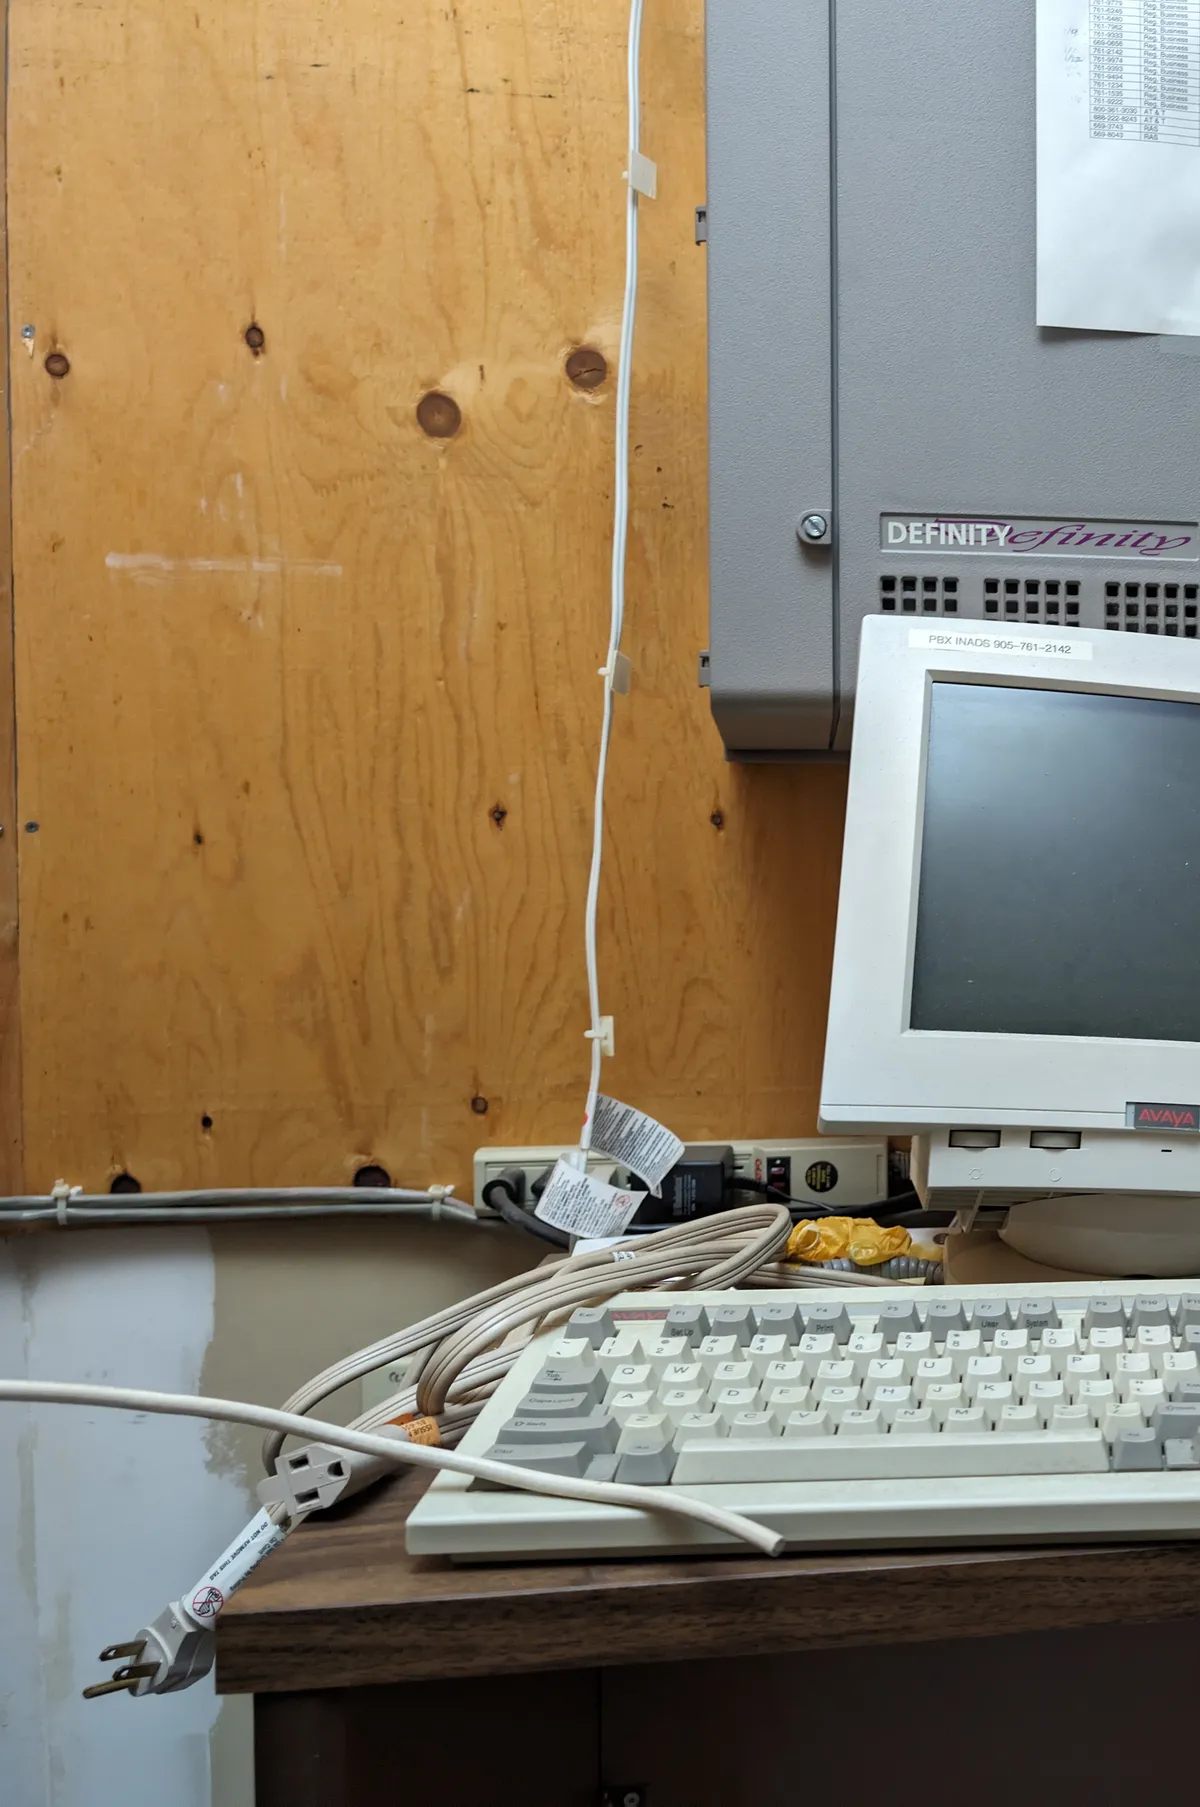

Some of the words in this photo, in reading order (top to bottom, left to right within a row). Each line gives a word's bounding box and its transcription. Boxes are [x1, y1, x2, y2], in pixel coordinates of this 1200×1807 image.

[887, 521, 1011, 547] DEFINITY
[929, 634, 953, 646] PBX
[955, 636, 991, 649] INADS
[1139, 1108, 1195, 1128] AVAYA
[816, 1323, 834, 1333] Print
[981, 1320, 999, 1328] User
[1025, 1319, 1049, 1329] System
[973, 1359, 978, 1367] I
[1023, 1357, 1035, 1365] O
[1072, 1356, 1082, 1364] P
[673, 1365, 690, 1374] W
[724, 1364, 736, 1372] E
[775, 1363, 786, 1371] R
[924, 1361, 935, 1369] U
[622, 1367, 635, 1376] Q
[674, 1391, 684, 1399] S
[250, 1529, 262, 1540] NOT
[230, 1539, 252, 1560] REMOVE
[218, 1559, 232, 1571] THIS
[208, 1570, 221, 1581] TAG
